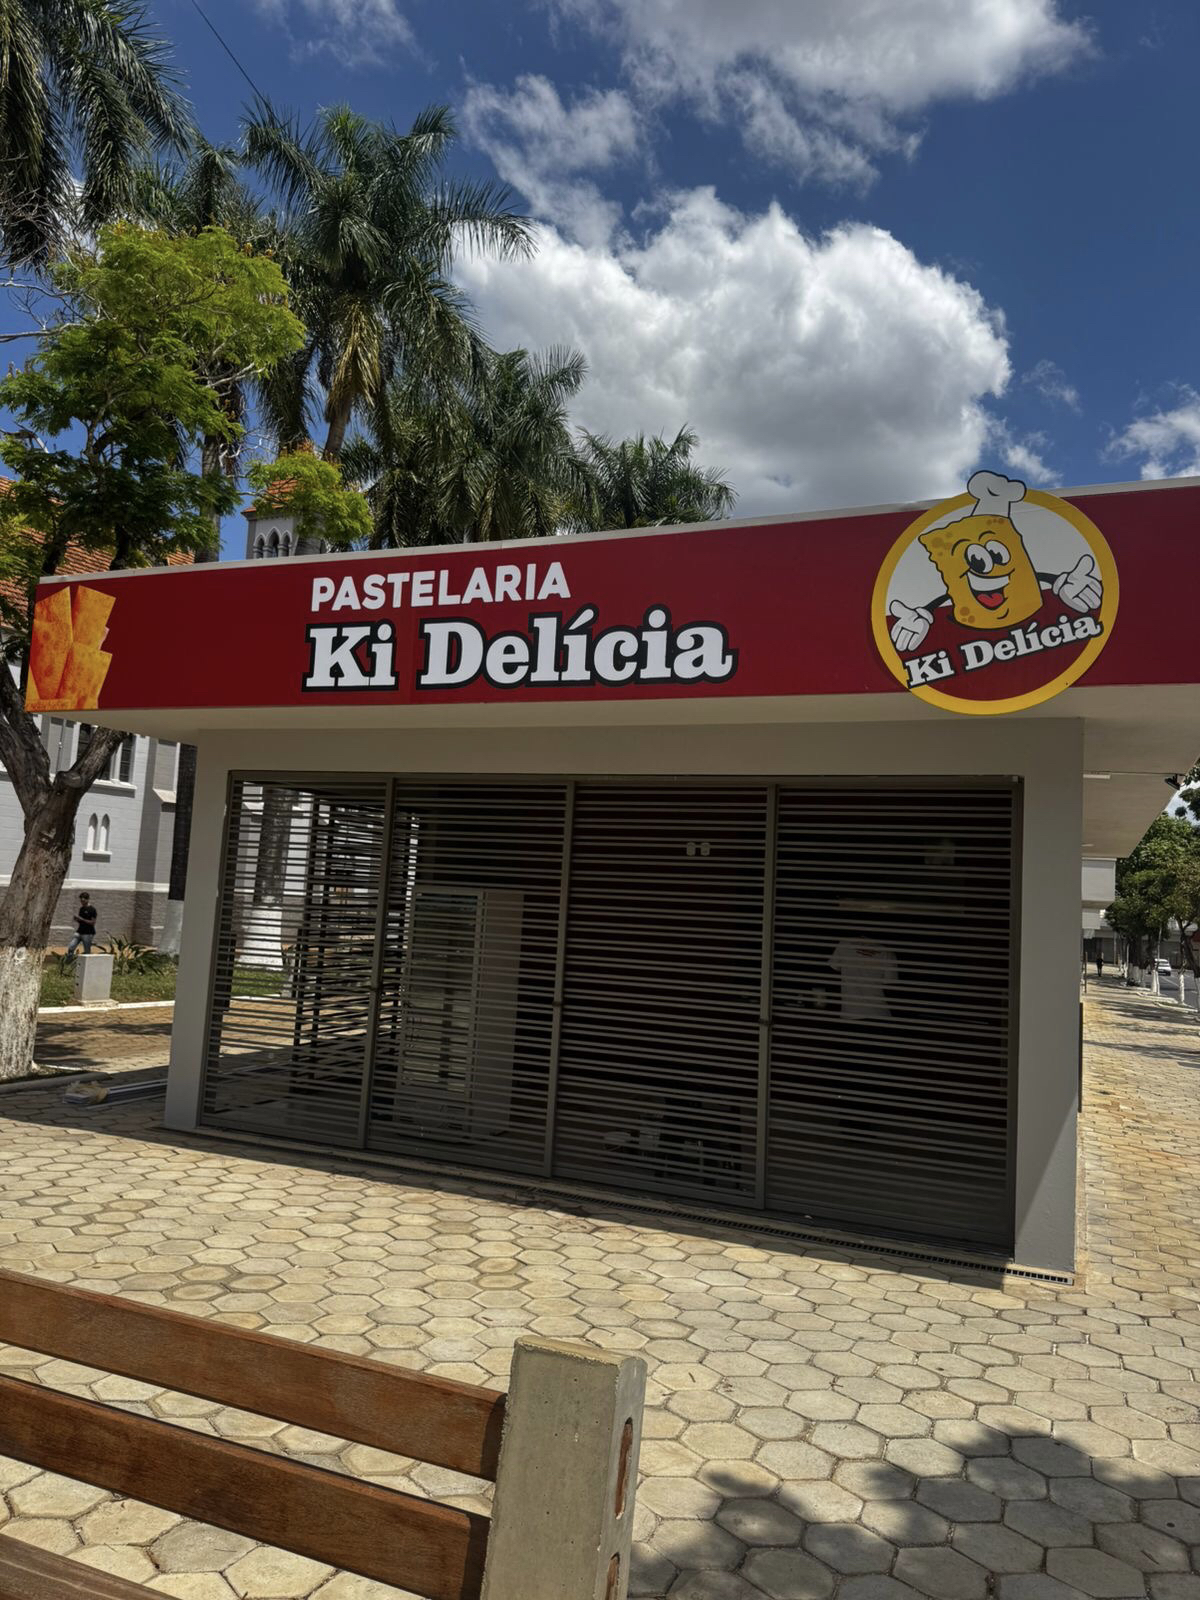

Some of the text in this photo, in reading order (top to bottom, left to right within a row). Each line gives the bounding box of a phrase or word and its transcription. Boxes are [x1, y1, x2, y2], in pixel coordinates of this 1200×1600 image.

[310, 561, 572, 612] PASTELARIA
[304, 606, 735, 689] Ki Delícia
[904, 614, 1102, 687] Ki Delícia
